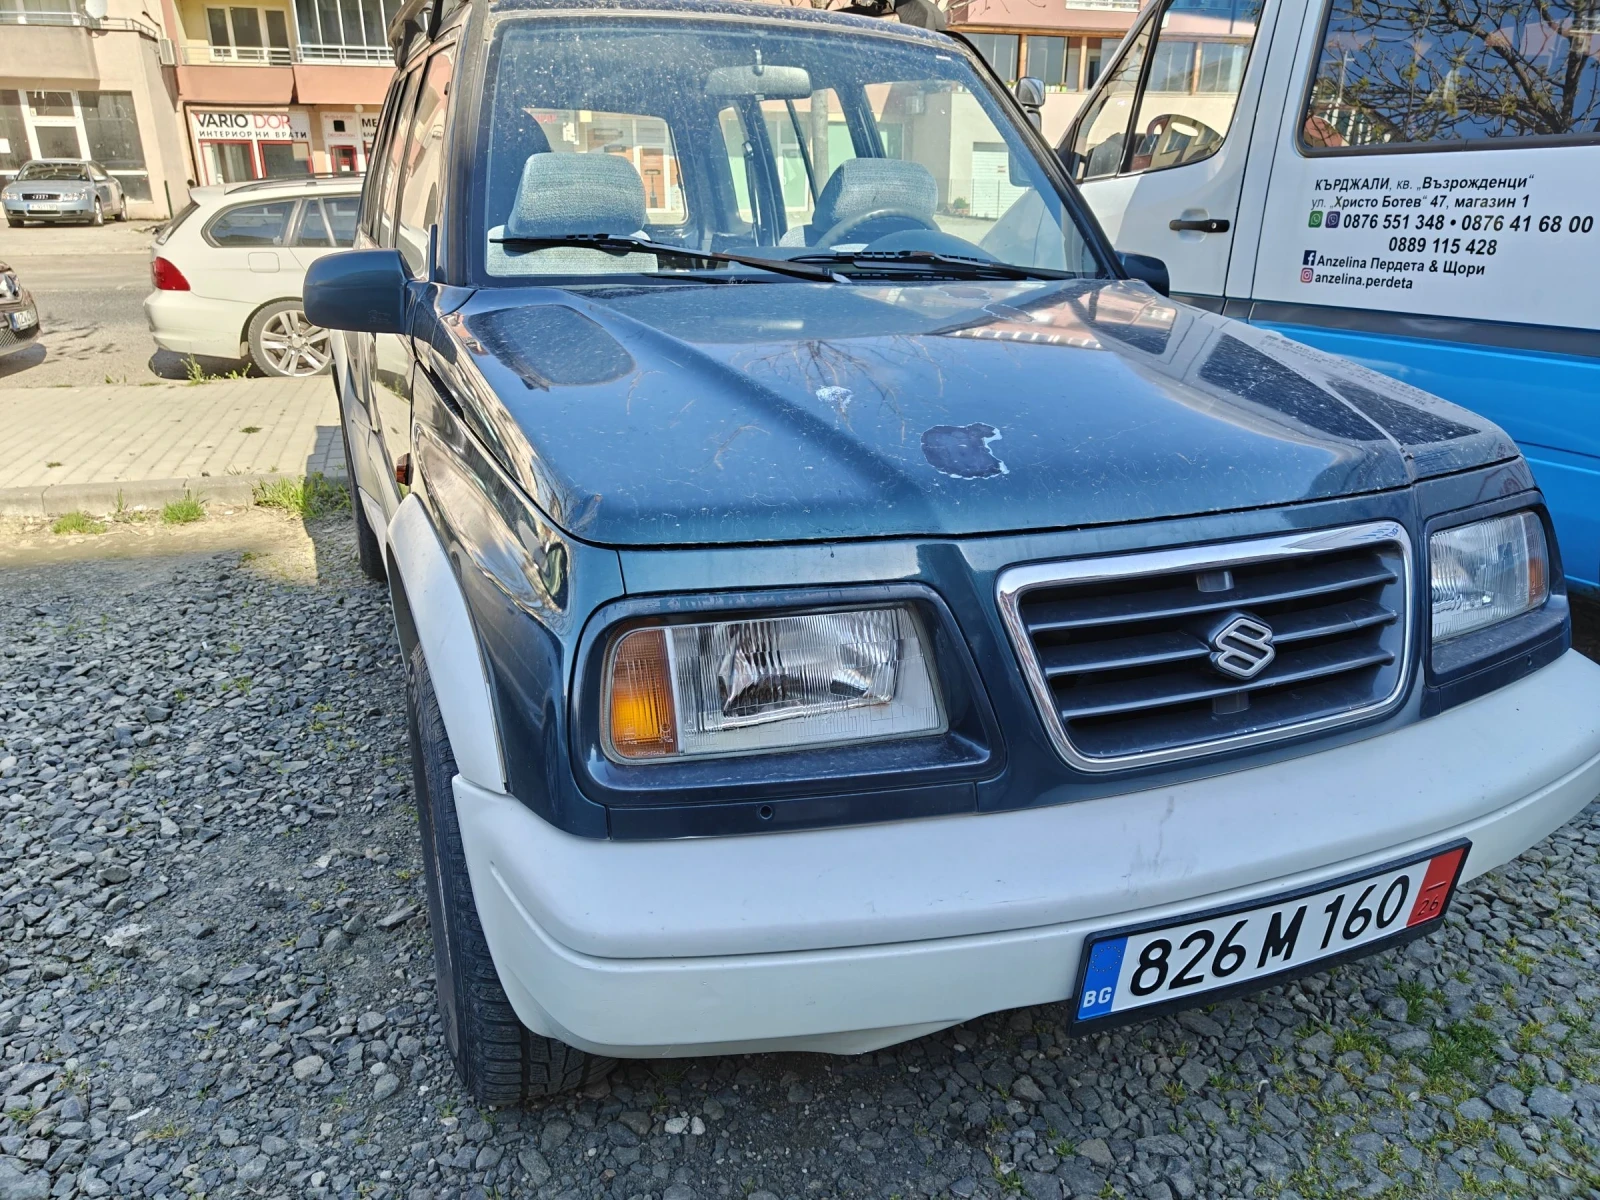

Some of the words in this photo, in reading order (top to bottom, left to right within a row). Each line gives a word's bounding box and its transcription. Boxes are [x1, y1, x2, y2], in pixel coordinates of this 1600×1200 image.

[195, 113, 248, 128] VARIO
[253, 114, 293, 129] DOR
[199, 130, 270, 138] ИНТЕРИОРНИ
[275, 131, 307, 139] ВРАТИ
[1315, 177, 1392, 192] КЪРДЖАЛИ,
[1310, 199, 1326, 210] ул.
[1430, 195, 1449, 210] 47,
[1454, 197, 1516, 208] магазин
[1522, 194, 1530, 208] 1
[1343, 213, 1378, 229] 0876
[1382, 214, 1410, 229] 551
[1415, 214, 1445, 230] 348
[1461, 214, 1504, 232] 0876
[1509, 215, 1531, 232] 41
[1538, 215, 1562, 233] 68
[1568, 215, 1594, 233] 00
[1388, 236, 1427, 253] 0889
[1432, 237, 1461, 254] 115
[1465, 238, 1497, 256] 428
[1316, 255, 1367, 269] Anzelina
[1370, 257, 1425, 273] Пердета
[1428, 259, 1439, 273] &
[1443, 260, 1486, 278] Щори
[1314, 272, 1414, 289] anzelina.perdeta
[1083, 986, 1112, 1008] BG
[1130, 919, 1249, 997] 826
[1256, 904, 1308, 970] M
[1320, 874, 1410, 950] 160
[1417, 894, 1439, 917] 26
